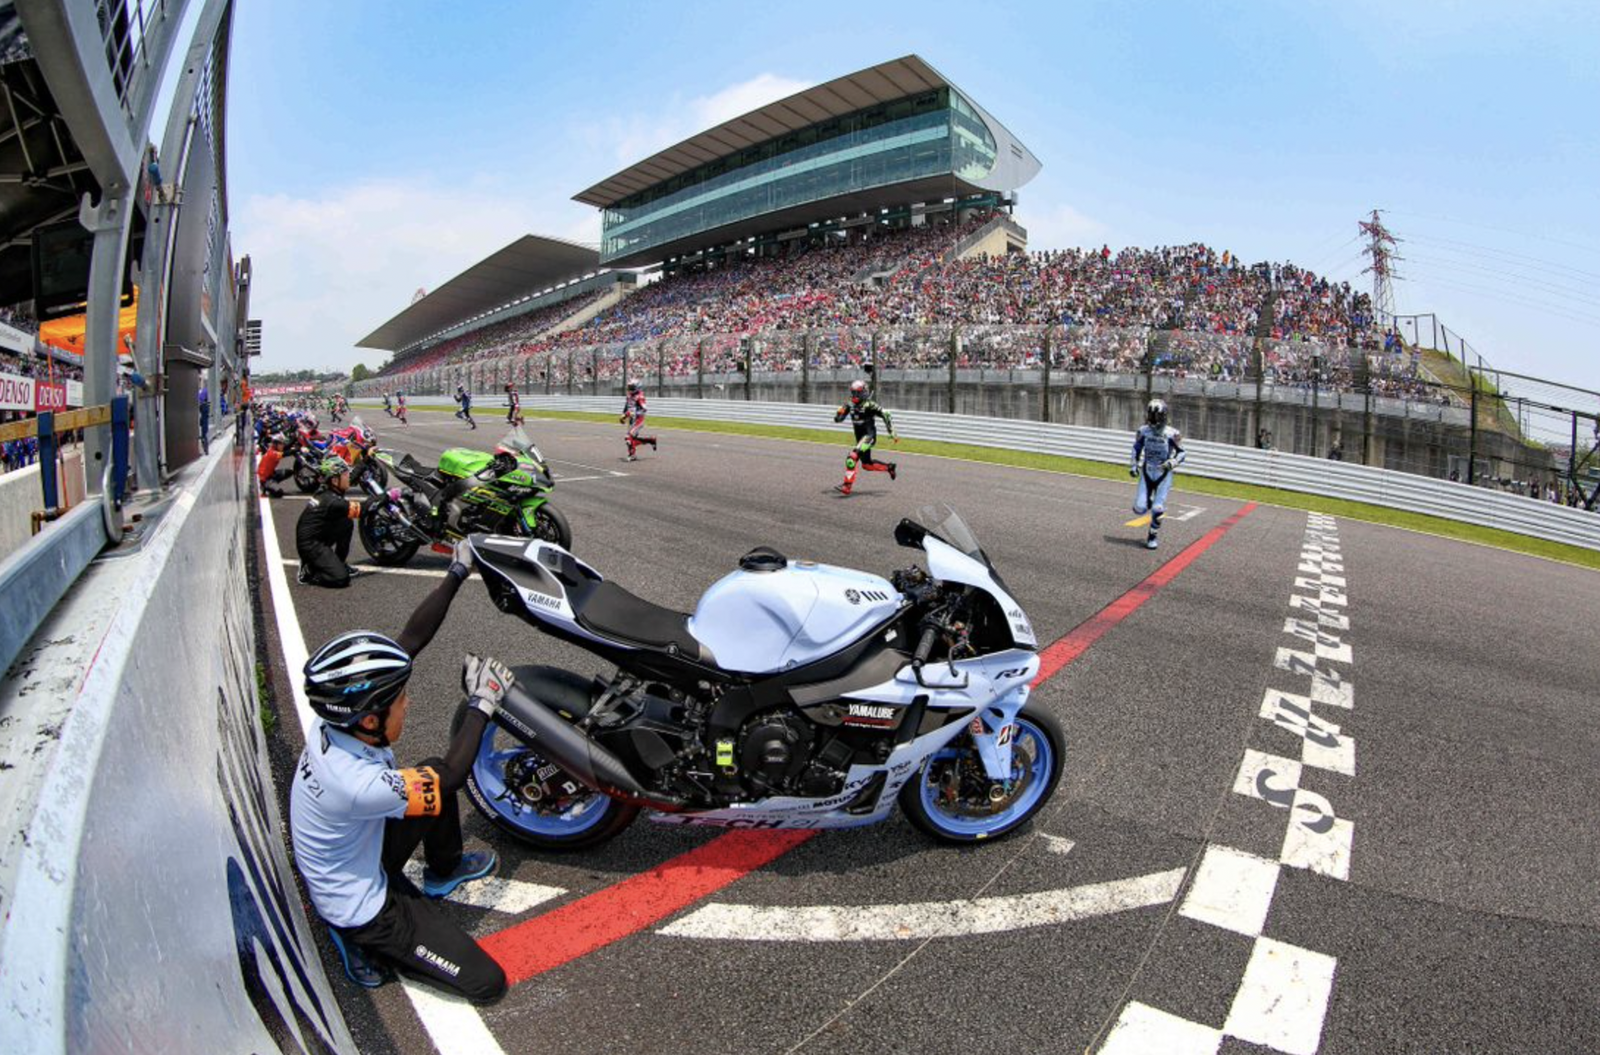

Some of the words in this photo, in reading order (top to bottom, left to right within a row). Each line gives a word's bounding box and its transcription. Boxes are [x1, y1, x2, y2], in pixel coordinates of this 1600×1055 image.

[0, 378, 30, 405] DENSO
[527, 591, 562, 611] YAMAHA
[995, 666, 1030, 680] R1
[848, 703, 896, 720] YAMALUBE
[426, 950, 461, 977] YAMAHA
